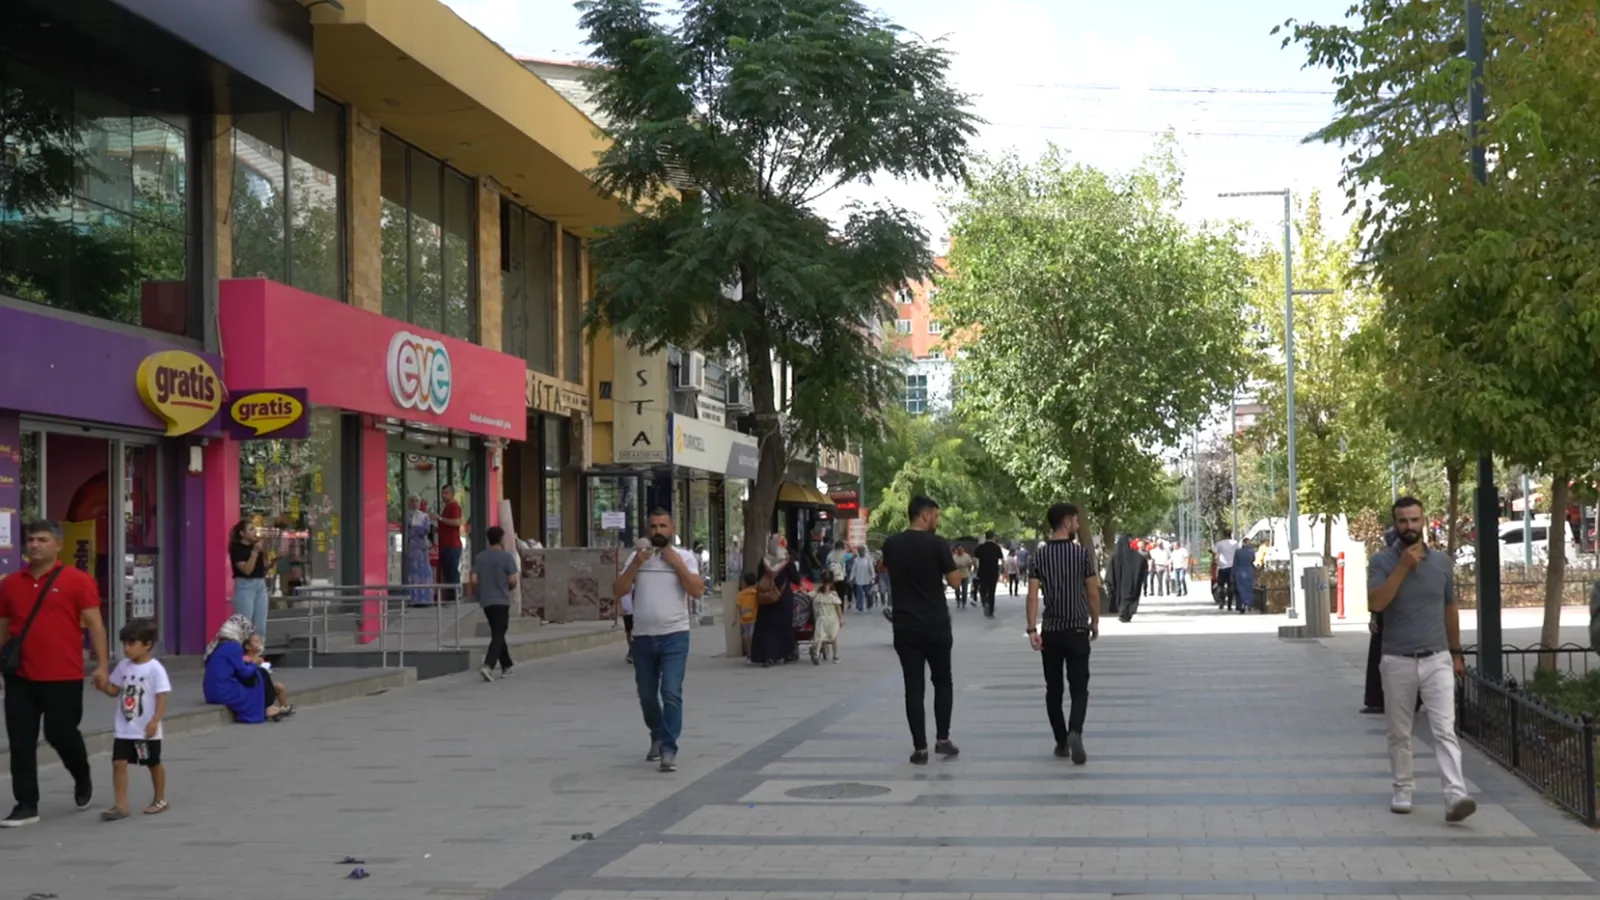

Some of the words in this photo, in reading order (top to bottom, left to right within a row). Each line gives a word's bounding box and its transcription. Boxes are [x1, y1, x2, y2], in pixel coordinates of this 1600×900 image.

[155, 365, 214, 403] gratis
[397, 340, 450, 406] eve
[239, 398, 293, 420] gratis
